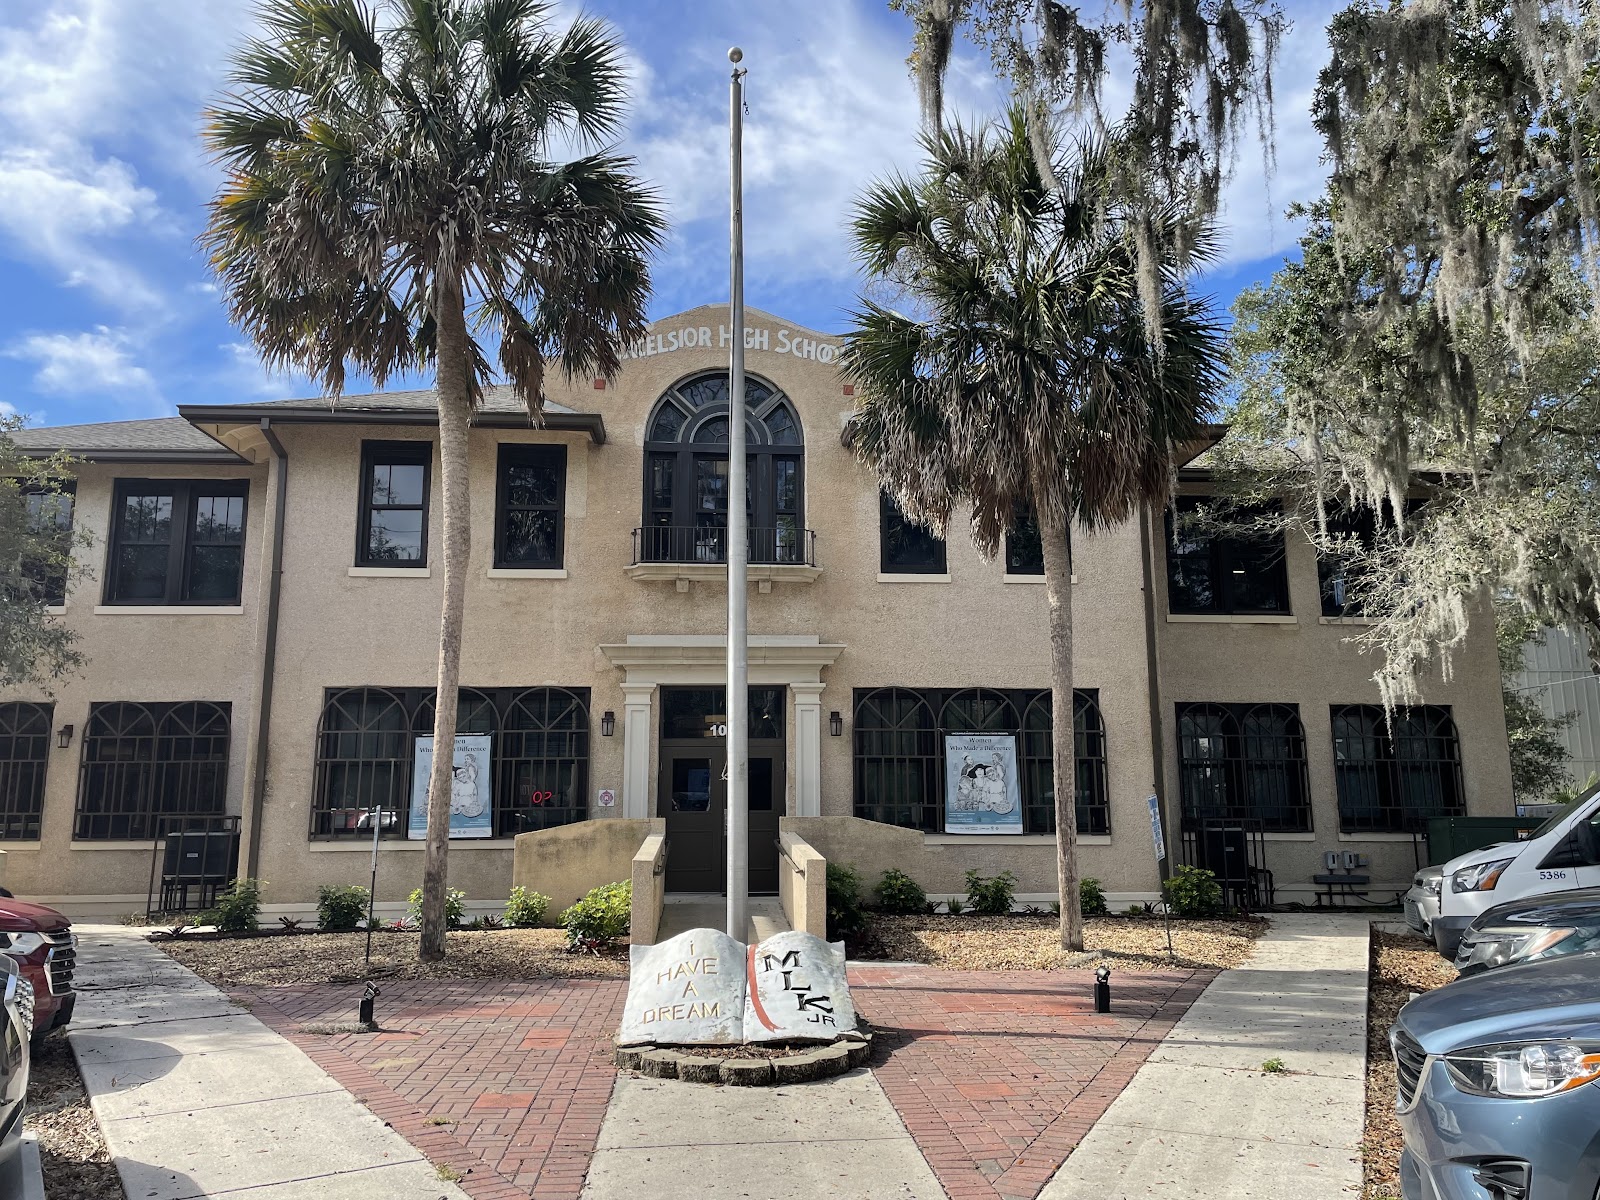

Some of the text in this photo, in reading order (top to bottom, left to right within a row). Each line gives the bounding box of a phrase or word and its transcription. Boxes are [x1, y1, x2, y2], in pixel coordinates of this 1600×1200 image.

[613, 326, 712, 361] CELSIOR
[719, 325, 769, 350] HGH
[1539, 870, 1566, 880] 5386
[656, 957, 719, 985] HAVE
[682, 980, 698, 999] A
[643, 1001, 721, 1025] DREAM
[806, 1013, 836, 1027] JR
